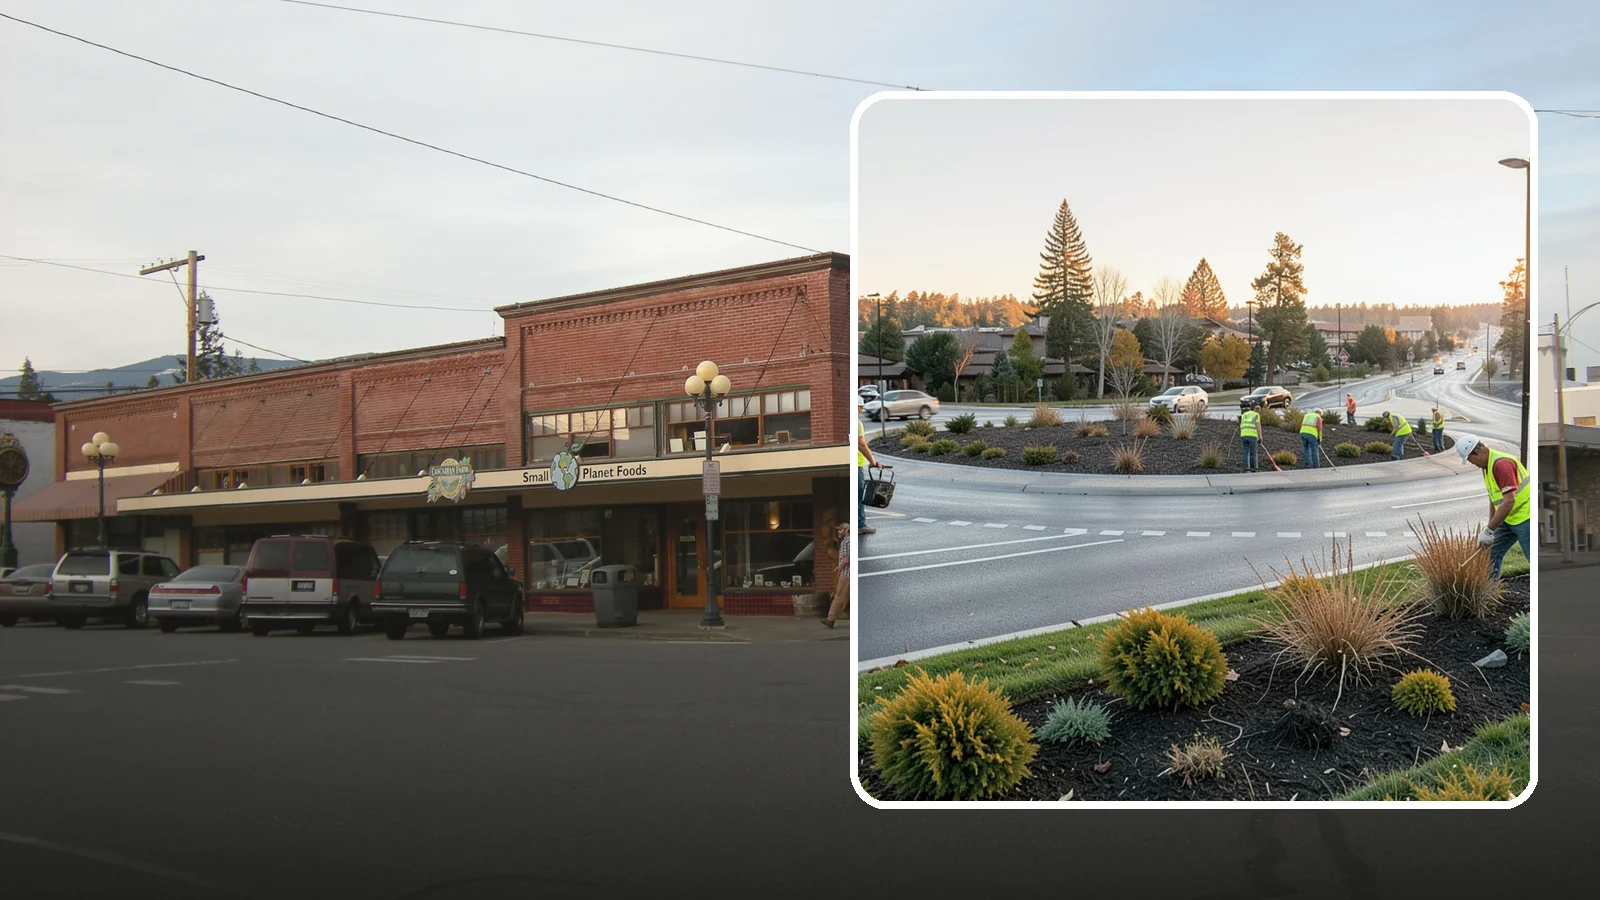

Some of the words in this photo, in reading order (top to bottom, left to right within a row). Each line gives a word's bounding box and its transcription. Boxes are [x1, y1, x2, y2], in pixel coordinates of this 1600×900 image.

[523, 471, 549, 483] Small
[583, 467, 614, 479] Planet
[617, 464, 647, 477] Foods
